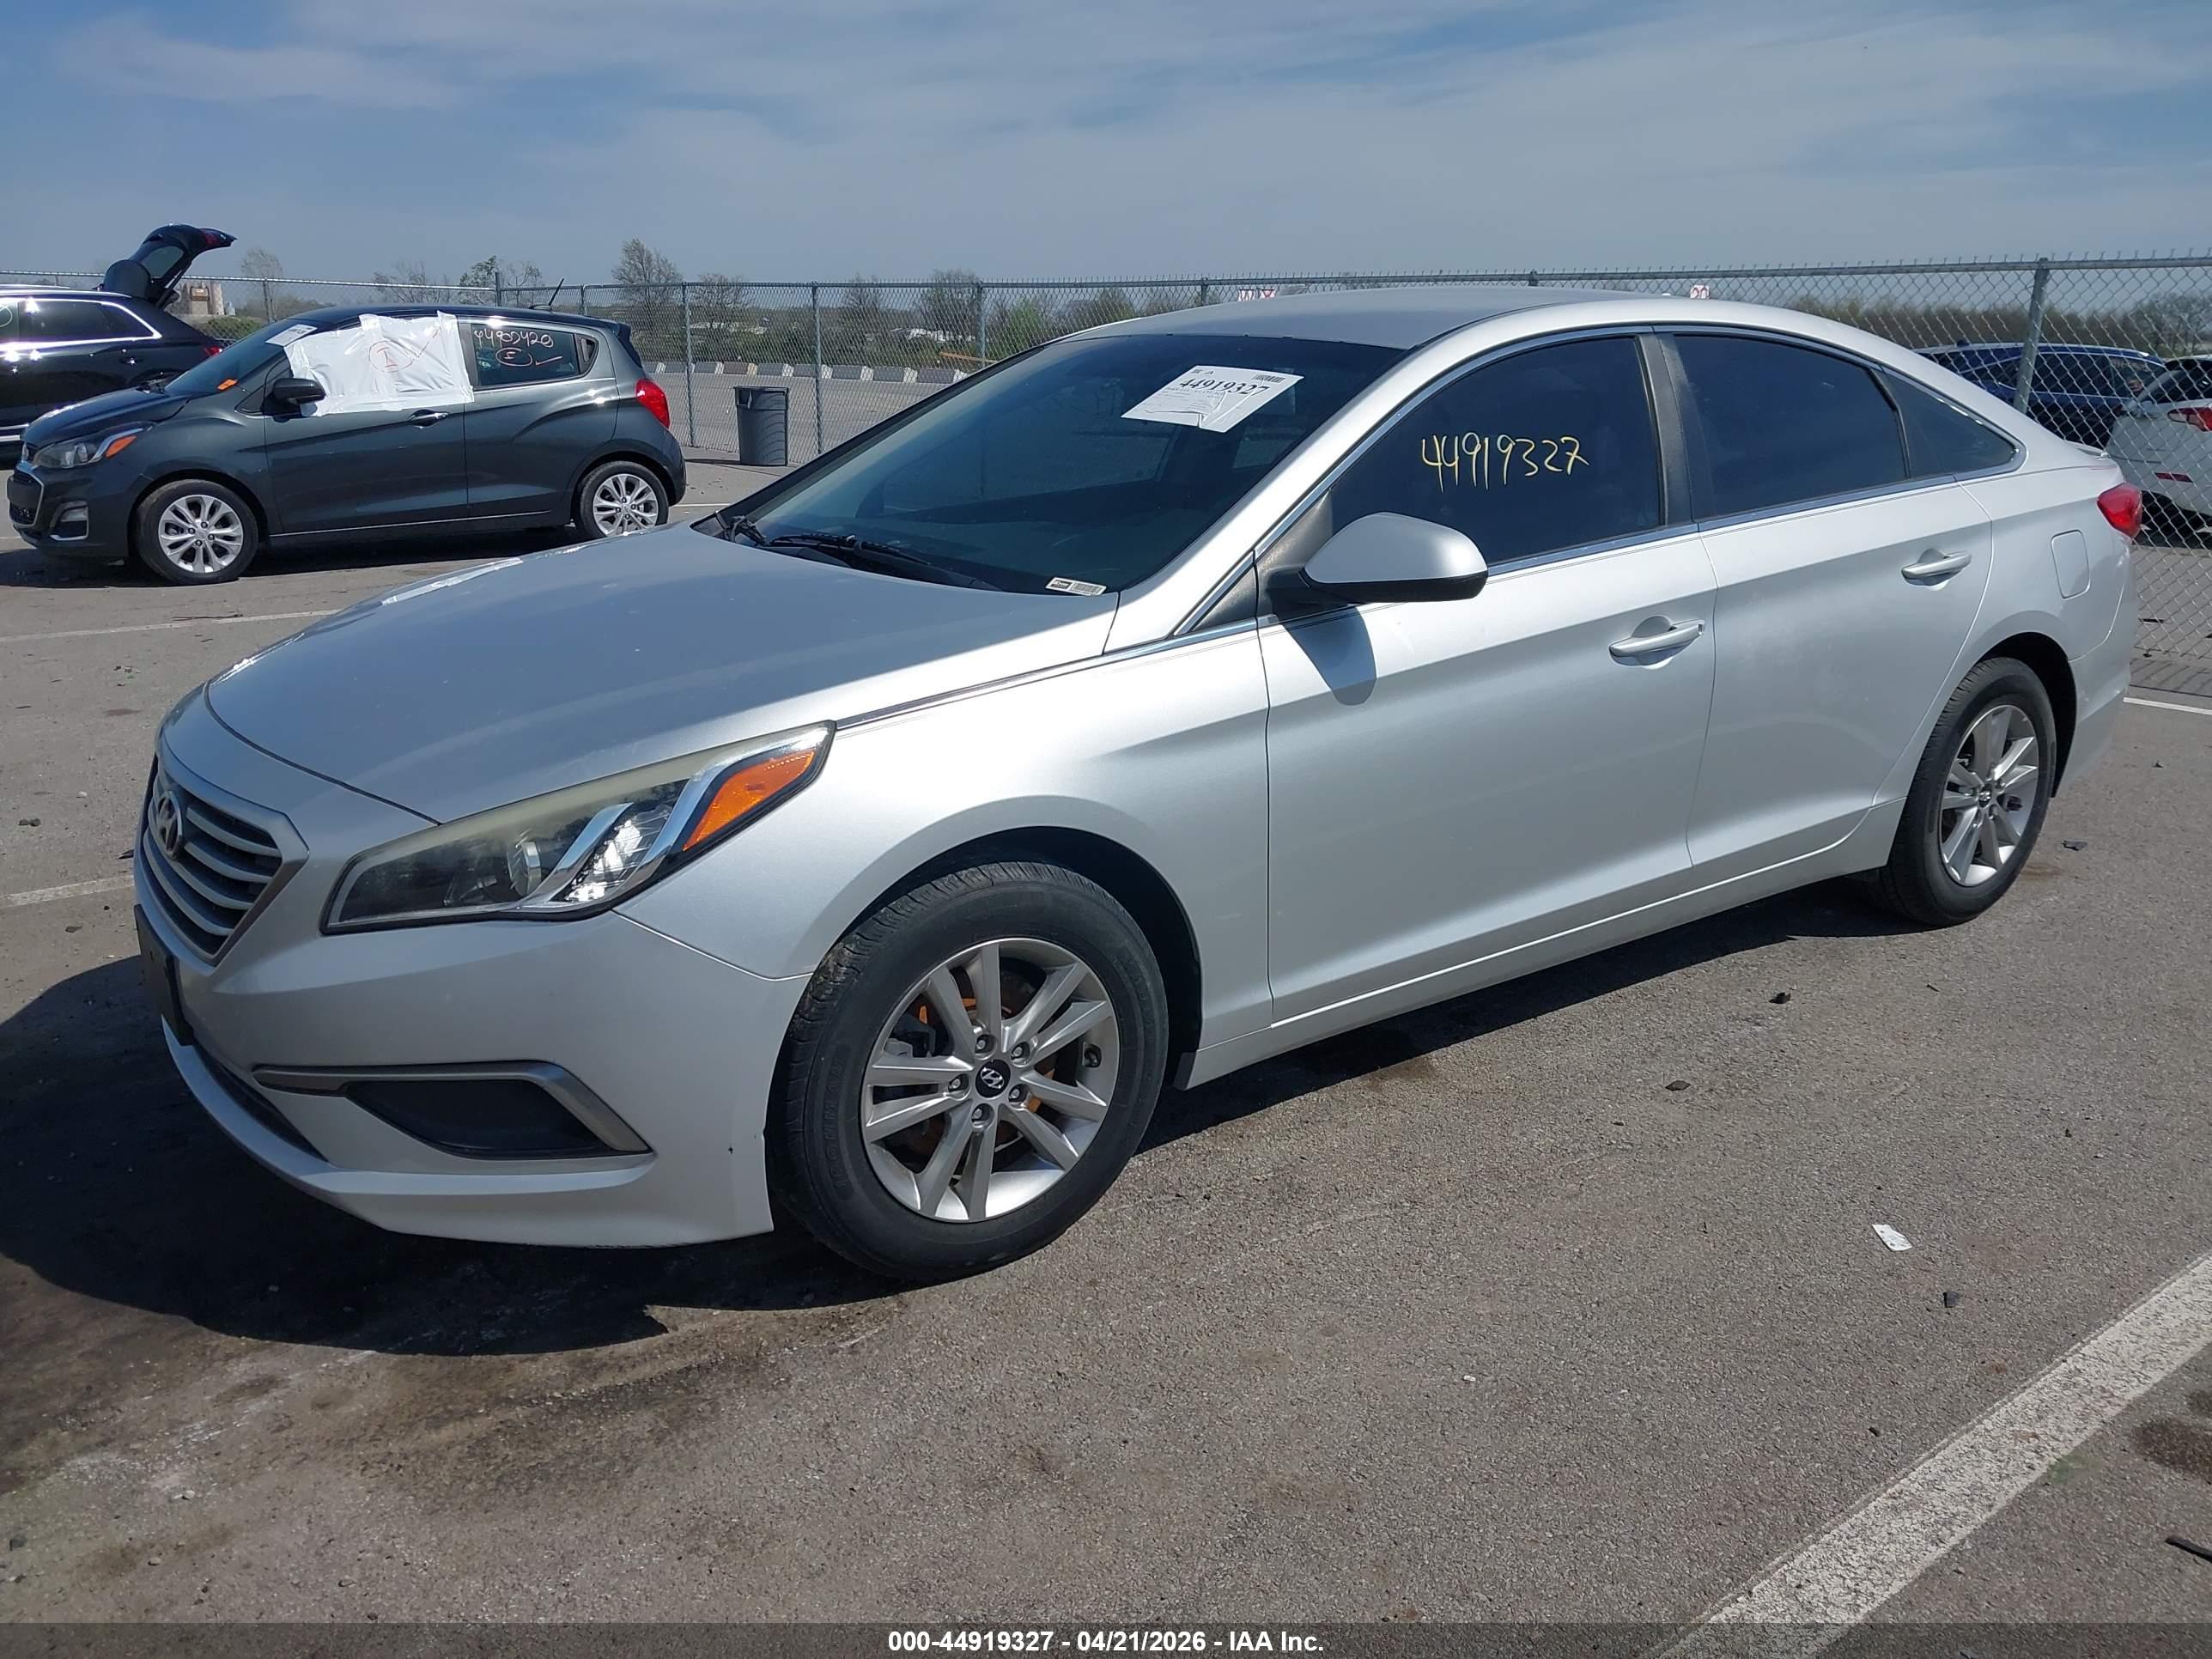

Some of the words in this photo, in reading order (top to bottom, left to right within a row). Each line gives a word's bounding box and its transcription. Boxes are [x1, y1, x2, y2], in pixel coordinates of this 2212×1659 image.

[1180, 378, 1270, 396] 44919327
[1422, 432, 1590, 493] 44919327
[823, 1057, 848, 1188] IRONMAN
